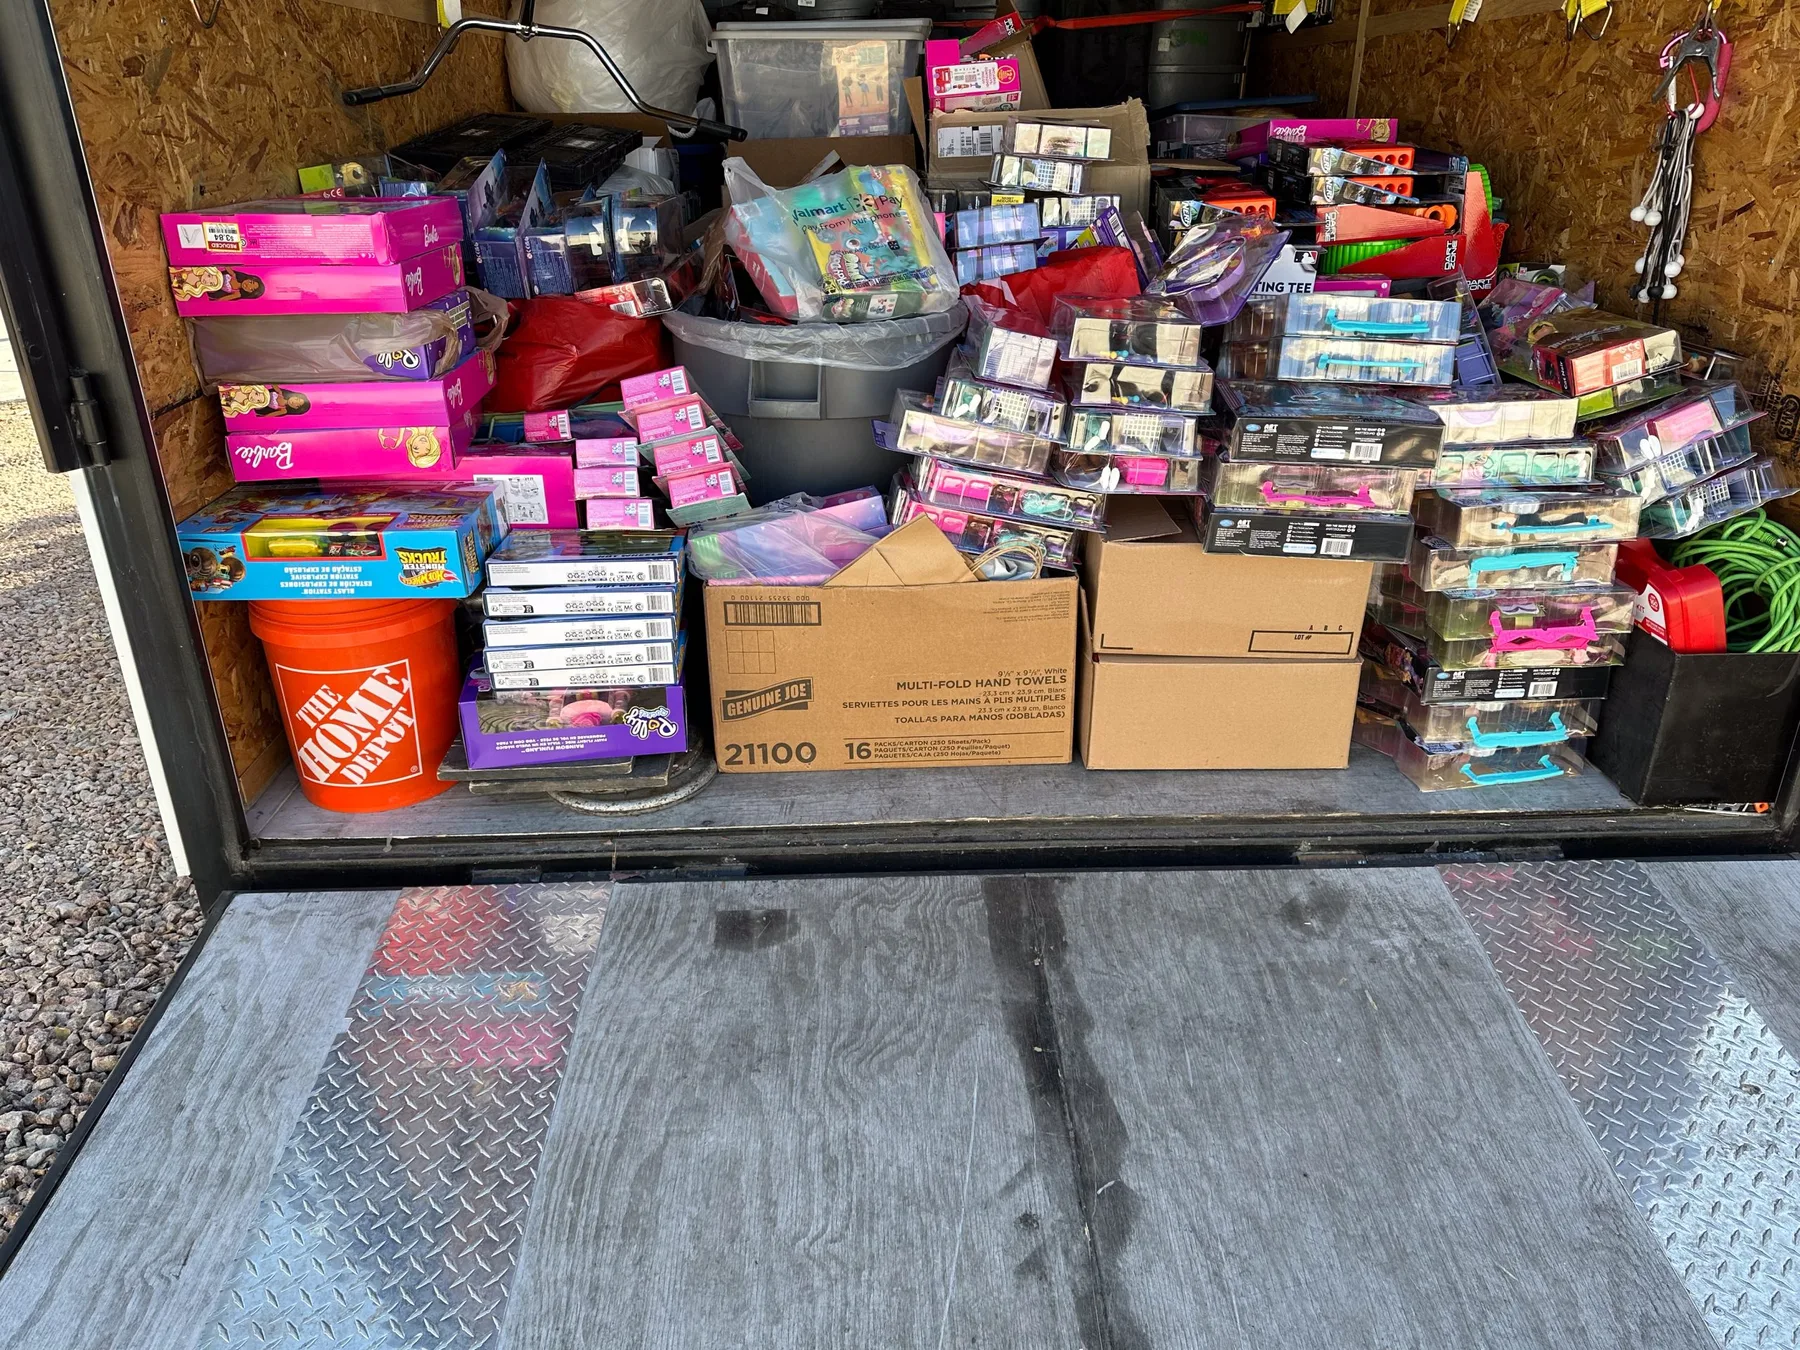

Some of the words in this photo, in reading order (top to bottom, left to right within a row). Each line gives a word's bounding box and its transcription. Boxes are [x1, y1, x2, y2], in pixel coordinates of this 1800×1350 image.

[1273, 124, 1308, 137] Barbie
[1322, 147, 1332, 173] NERF
[878, 194, 904, 208] Pay
[1325, 177, 1334, 202] NERF
[820, 219, 846, 231] from
[869, 211, 901, 222] phone
[1181, 201, 1192, 227] NERF
[213, 233, 235, 242] $3.84
[423, 223, 440, 248] Barbie
[1444, 240, 1453, 271] DART
[1450, 239, 1458, 270] ZONE
[405, 266, 424, 297] Barbie
[1288, 282, 1311, 293] TEE
[447, 377, 464, 409] Barbie
[235, 441, 294, 470] Barbie
[398, 550, 447, 564] TRUCKS
[896, 680, 972, 691] MULTI-FOLD
[975, 678, 1011, 688] HAND
[1015, 675, 1067, 686] TOWELS
[1044, 667, 1068, 675] White
[295, 683, 344, 730] THE
[727, 688, 782, 717] GENUINE
[784, 682, 807, 701] JOE
[842, 700, 899, 709] SERVIETTES
[902, 699, 929, 707] POUR
[951, 697, 981, 705] MAINS
[983, 694, 991, 704] À
[993, 696, 1013, 704] PLIS
[1015, 693, 1066, 703] MULTIPLES
[297, 666, 412, 783] HOME
[625, 708, 678, 738] Polly
[894, 716, 938, 724] TOALLAS
[940, 714, 966, 722] PARA
[969, 713, 1003, 721] MANOS
[1005, 711, 1065, 721] (DOBLADAS)
[339, 705, 417, 786] DEPOT
[724, 741, 817, 766] 21100
[844, 742, 872, 760] 16
[947, 738, 991, 746] Sheets/Pack)
[950, 750, 1001, 758] Hojas/Paquete)
